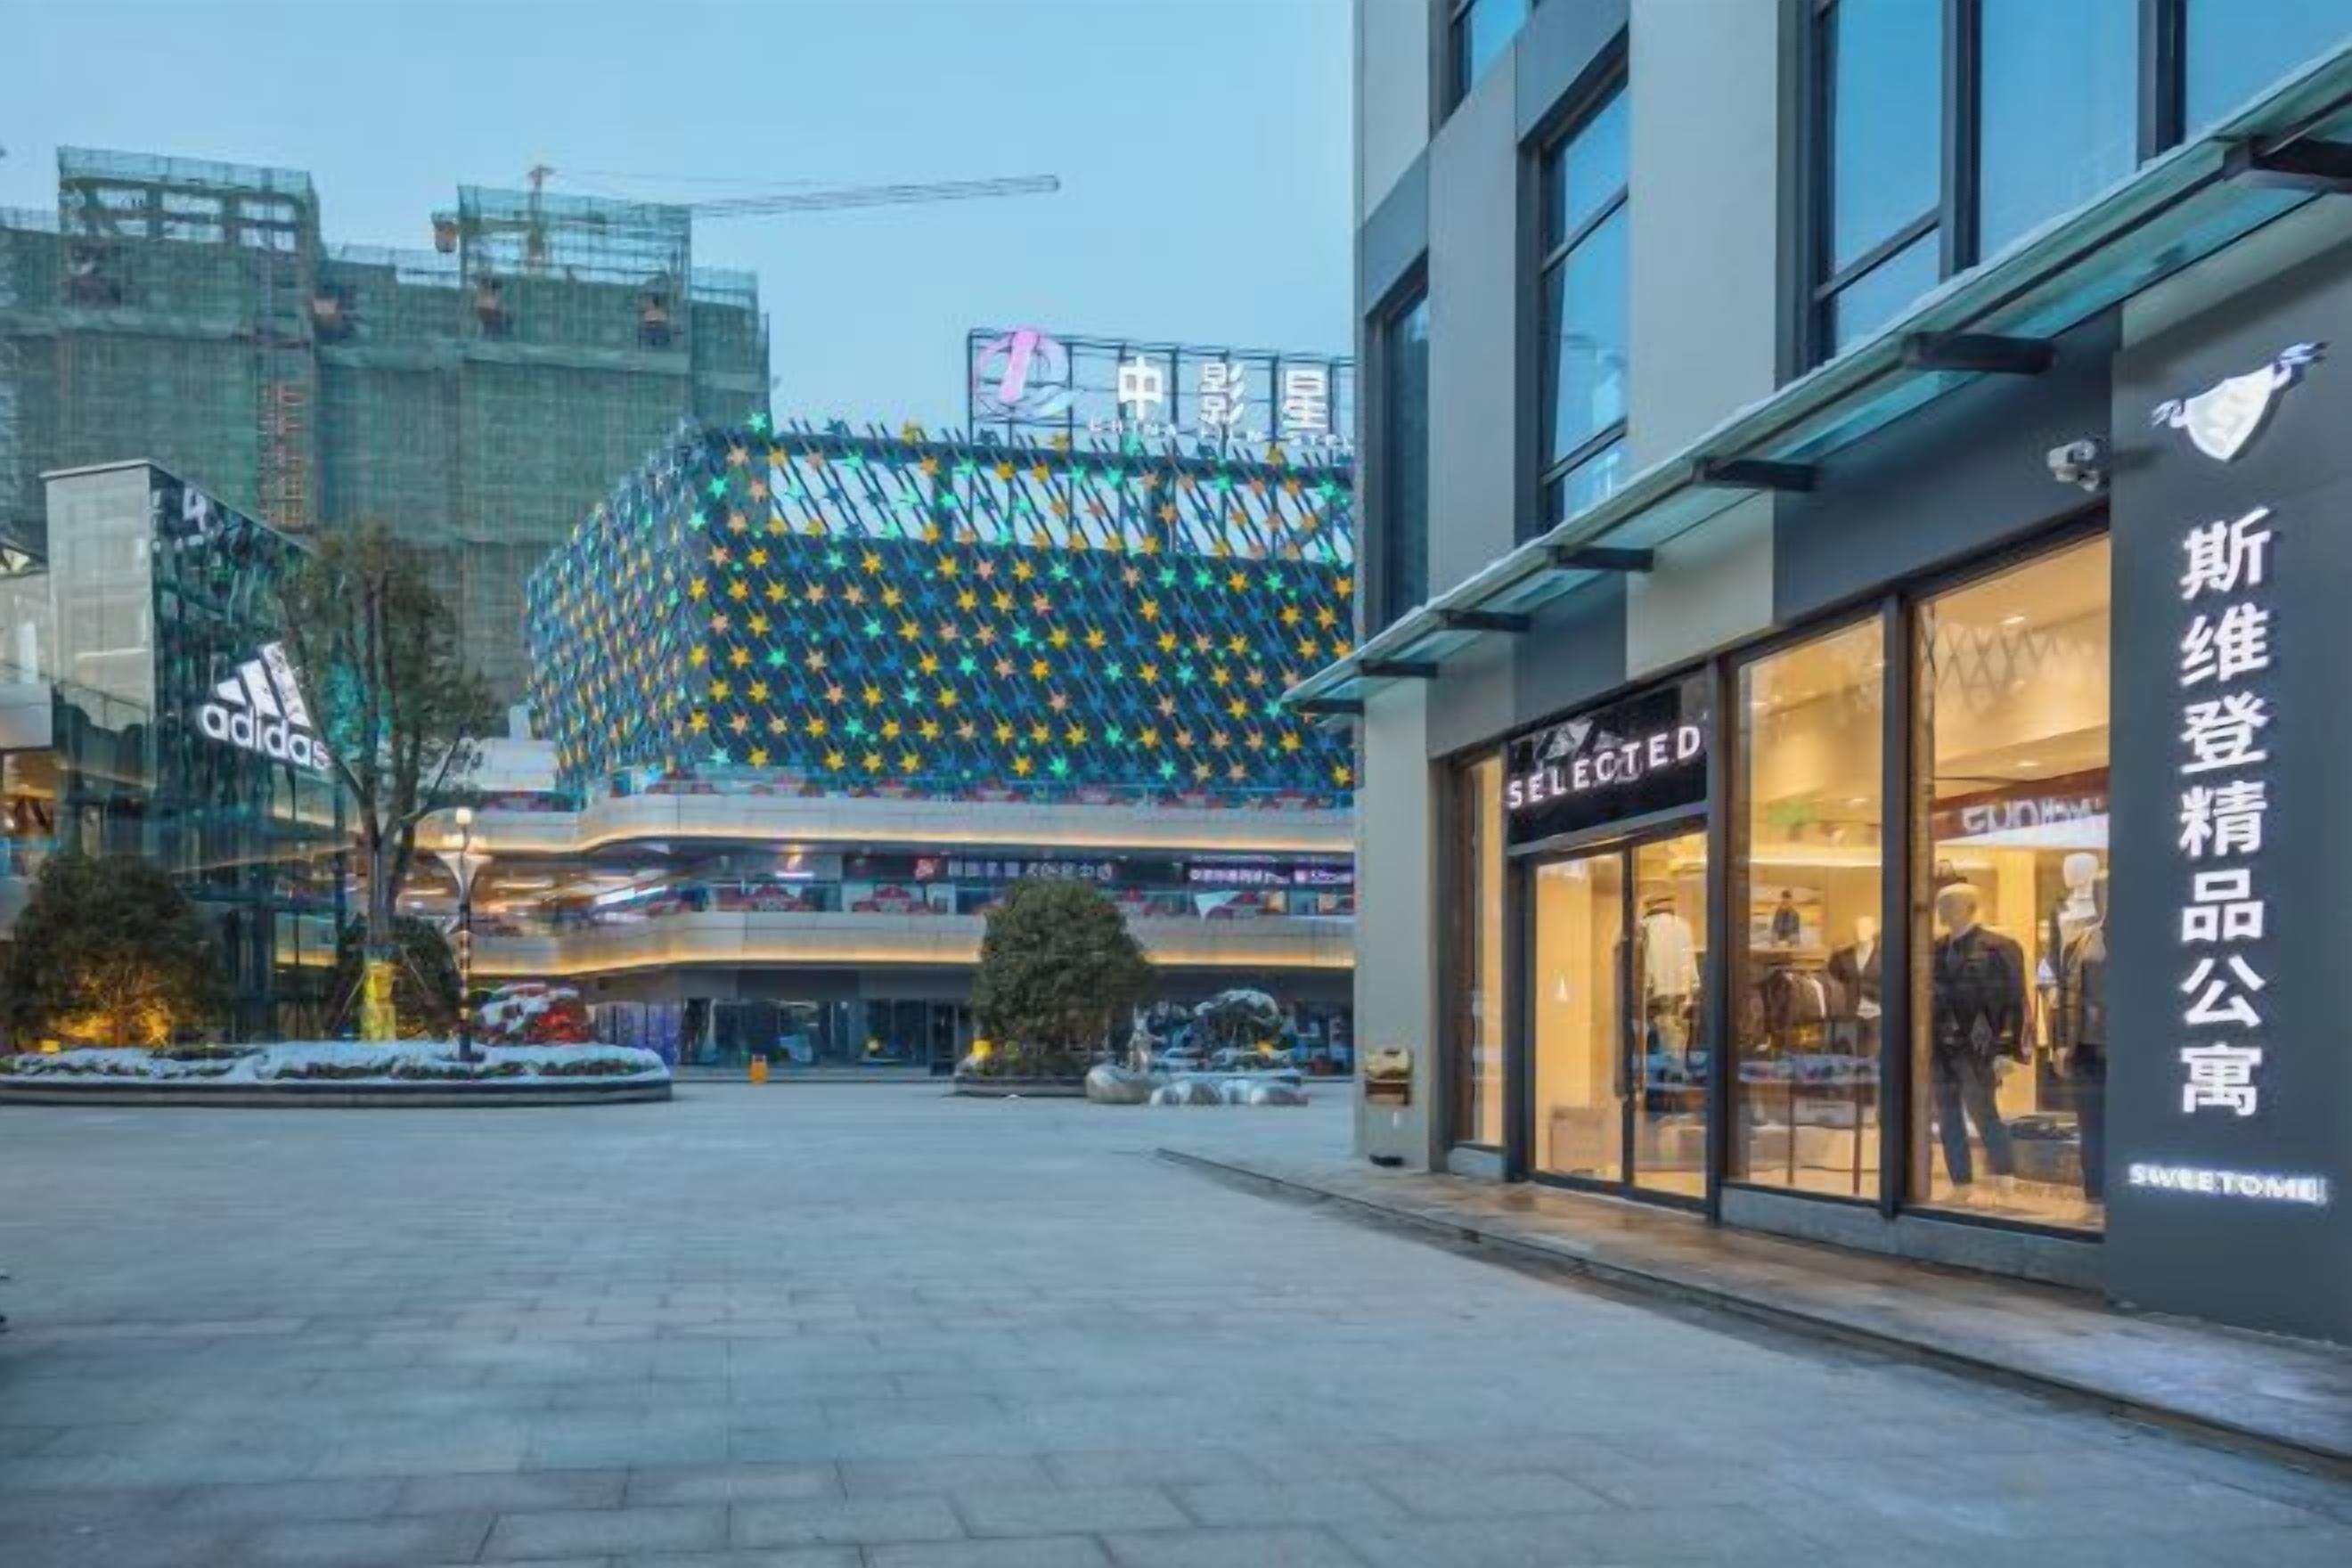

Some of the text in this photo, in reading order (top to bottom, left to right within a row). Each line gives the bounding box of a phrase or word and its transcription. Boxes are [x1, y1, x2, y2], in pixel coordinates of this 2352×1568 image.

[1118, 355, 1327, 429] 中影星
[201, 703, 332, 770] adidas
[1507, 725, 1701, 810] SELECTED
[2179, 507, 2271, 1115] 斯维登精品公寓
